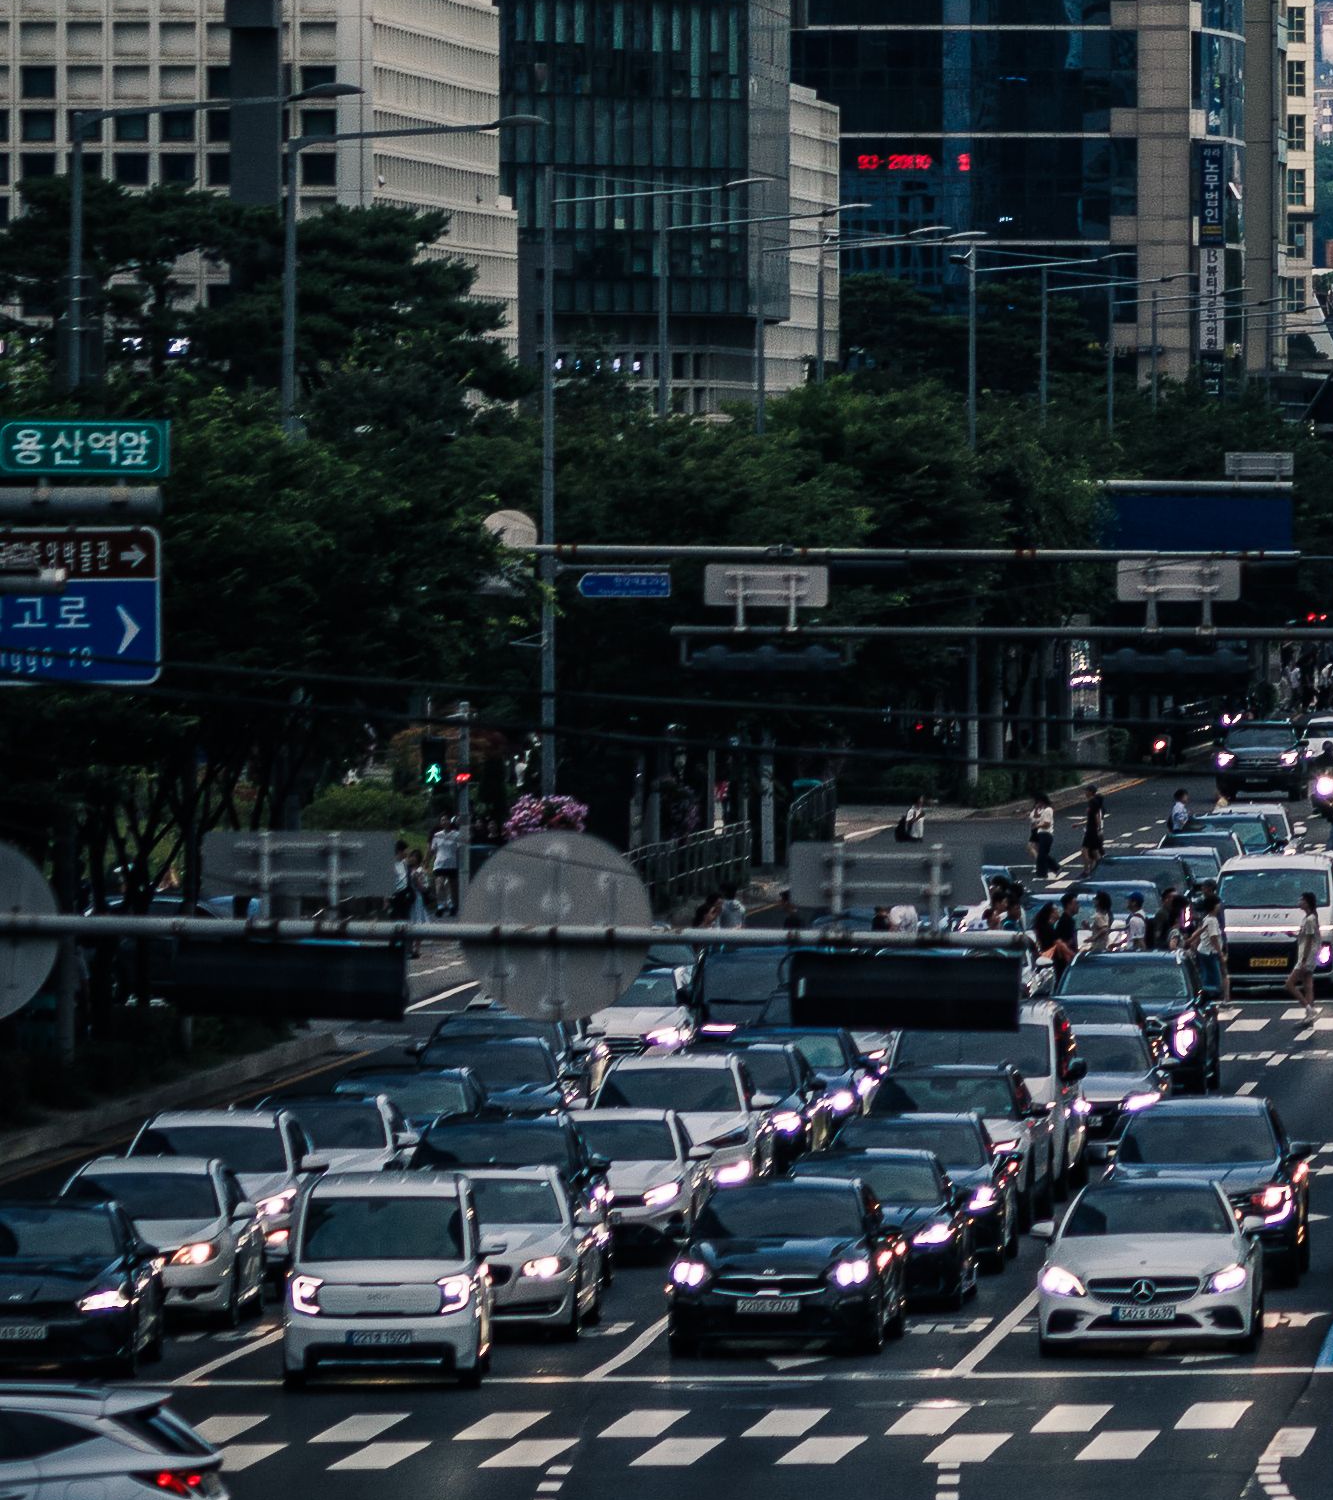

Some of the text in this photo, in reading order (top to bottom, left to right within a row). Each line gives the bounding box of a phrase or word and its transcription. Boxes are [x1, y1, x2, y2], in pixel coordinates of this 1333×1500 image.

[1204, 159, 1220, 224] 노무법인
[12, 428, 153, 467] 용산역앞
[0, 596, 92, 629] 고로
